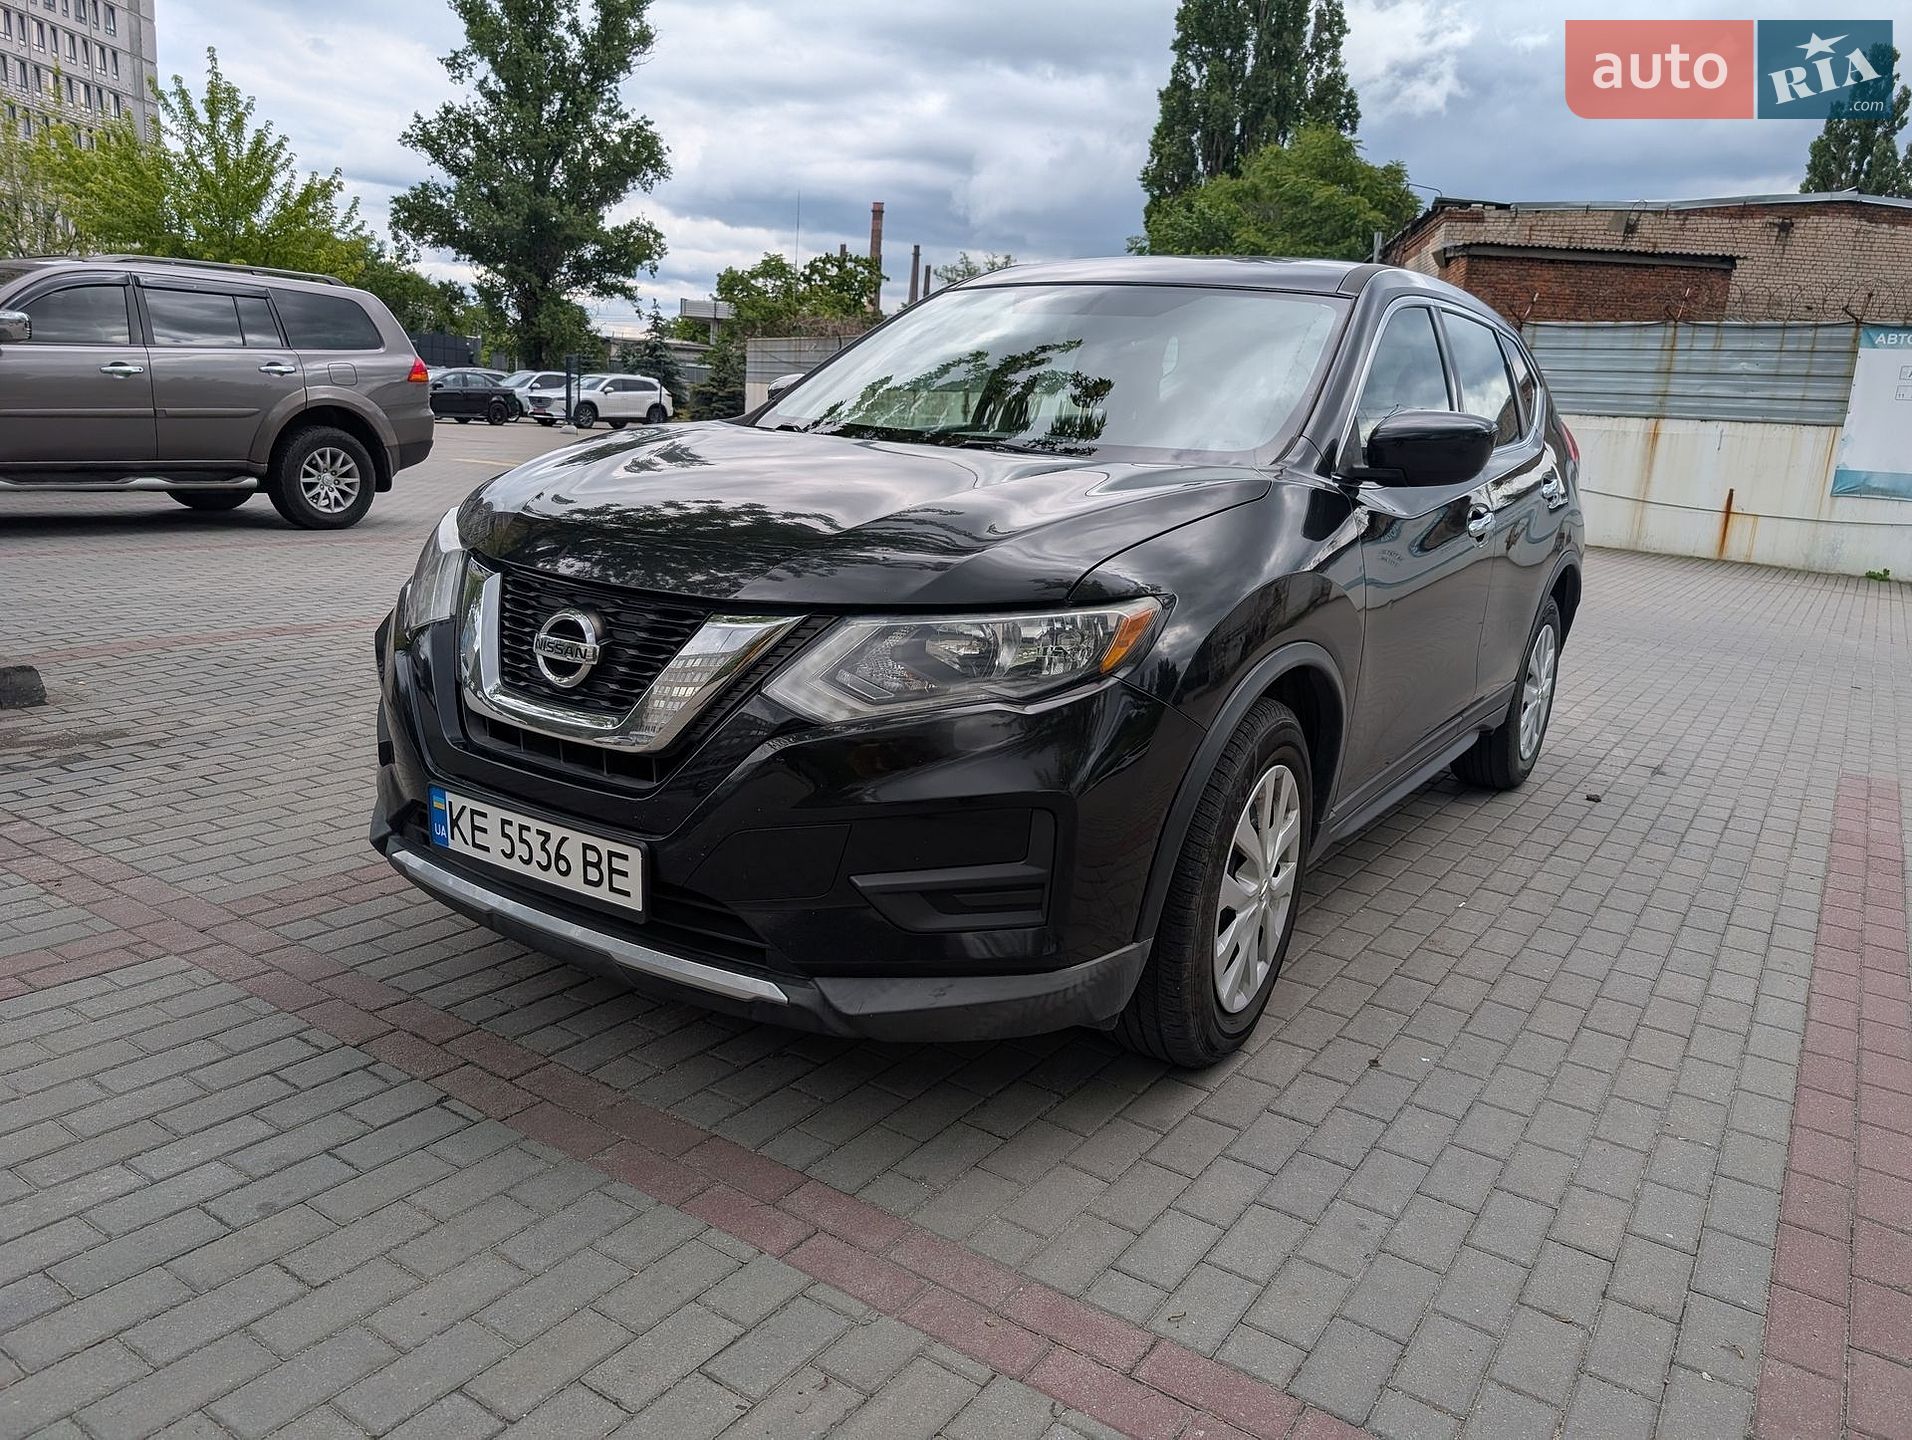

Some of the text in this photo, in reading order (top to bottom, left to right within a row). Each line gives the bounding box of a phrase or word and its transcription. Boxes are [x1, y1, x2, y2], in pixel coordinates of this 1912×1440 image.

[536, 636, 588, 660] NISSAN
[434, 822, 447, 839] UA
[448, 800, 631, 898] KE 5536 BE
